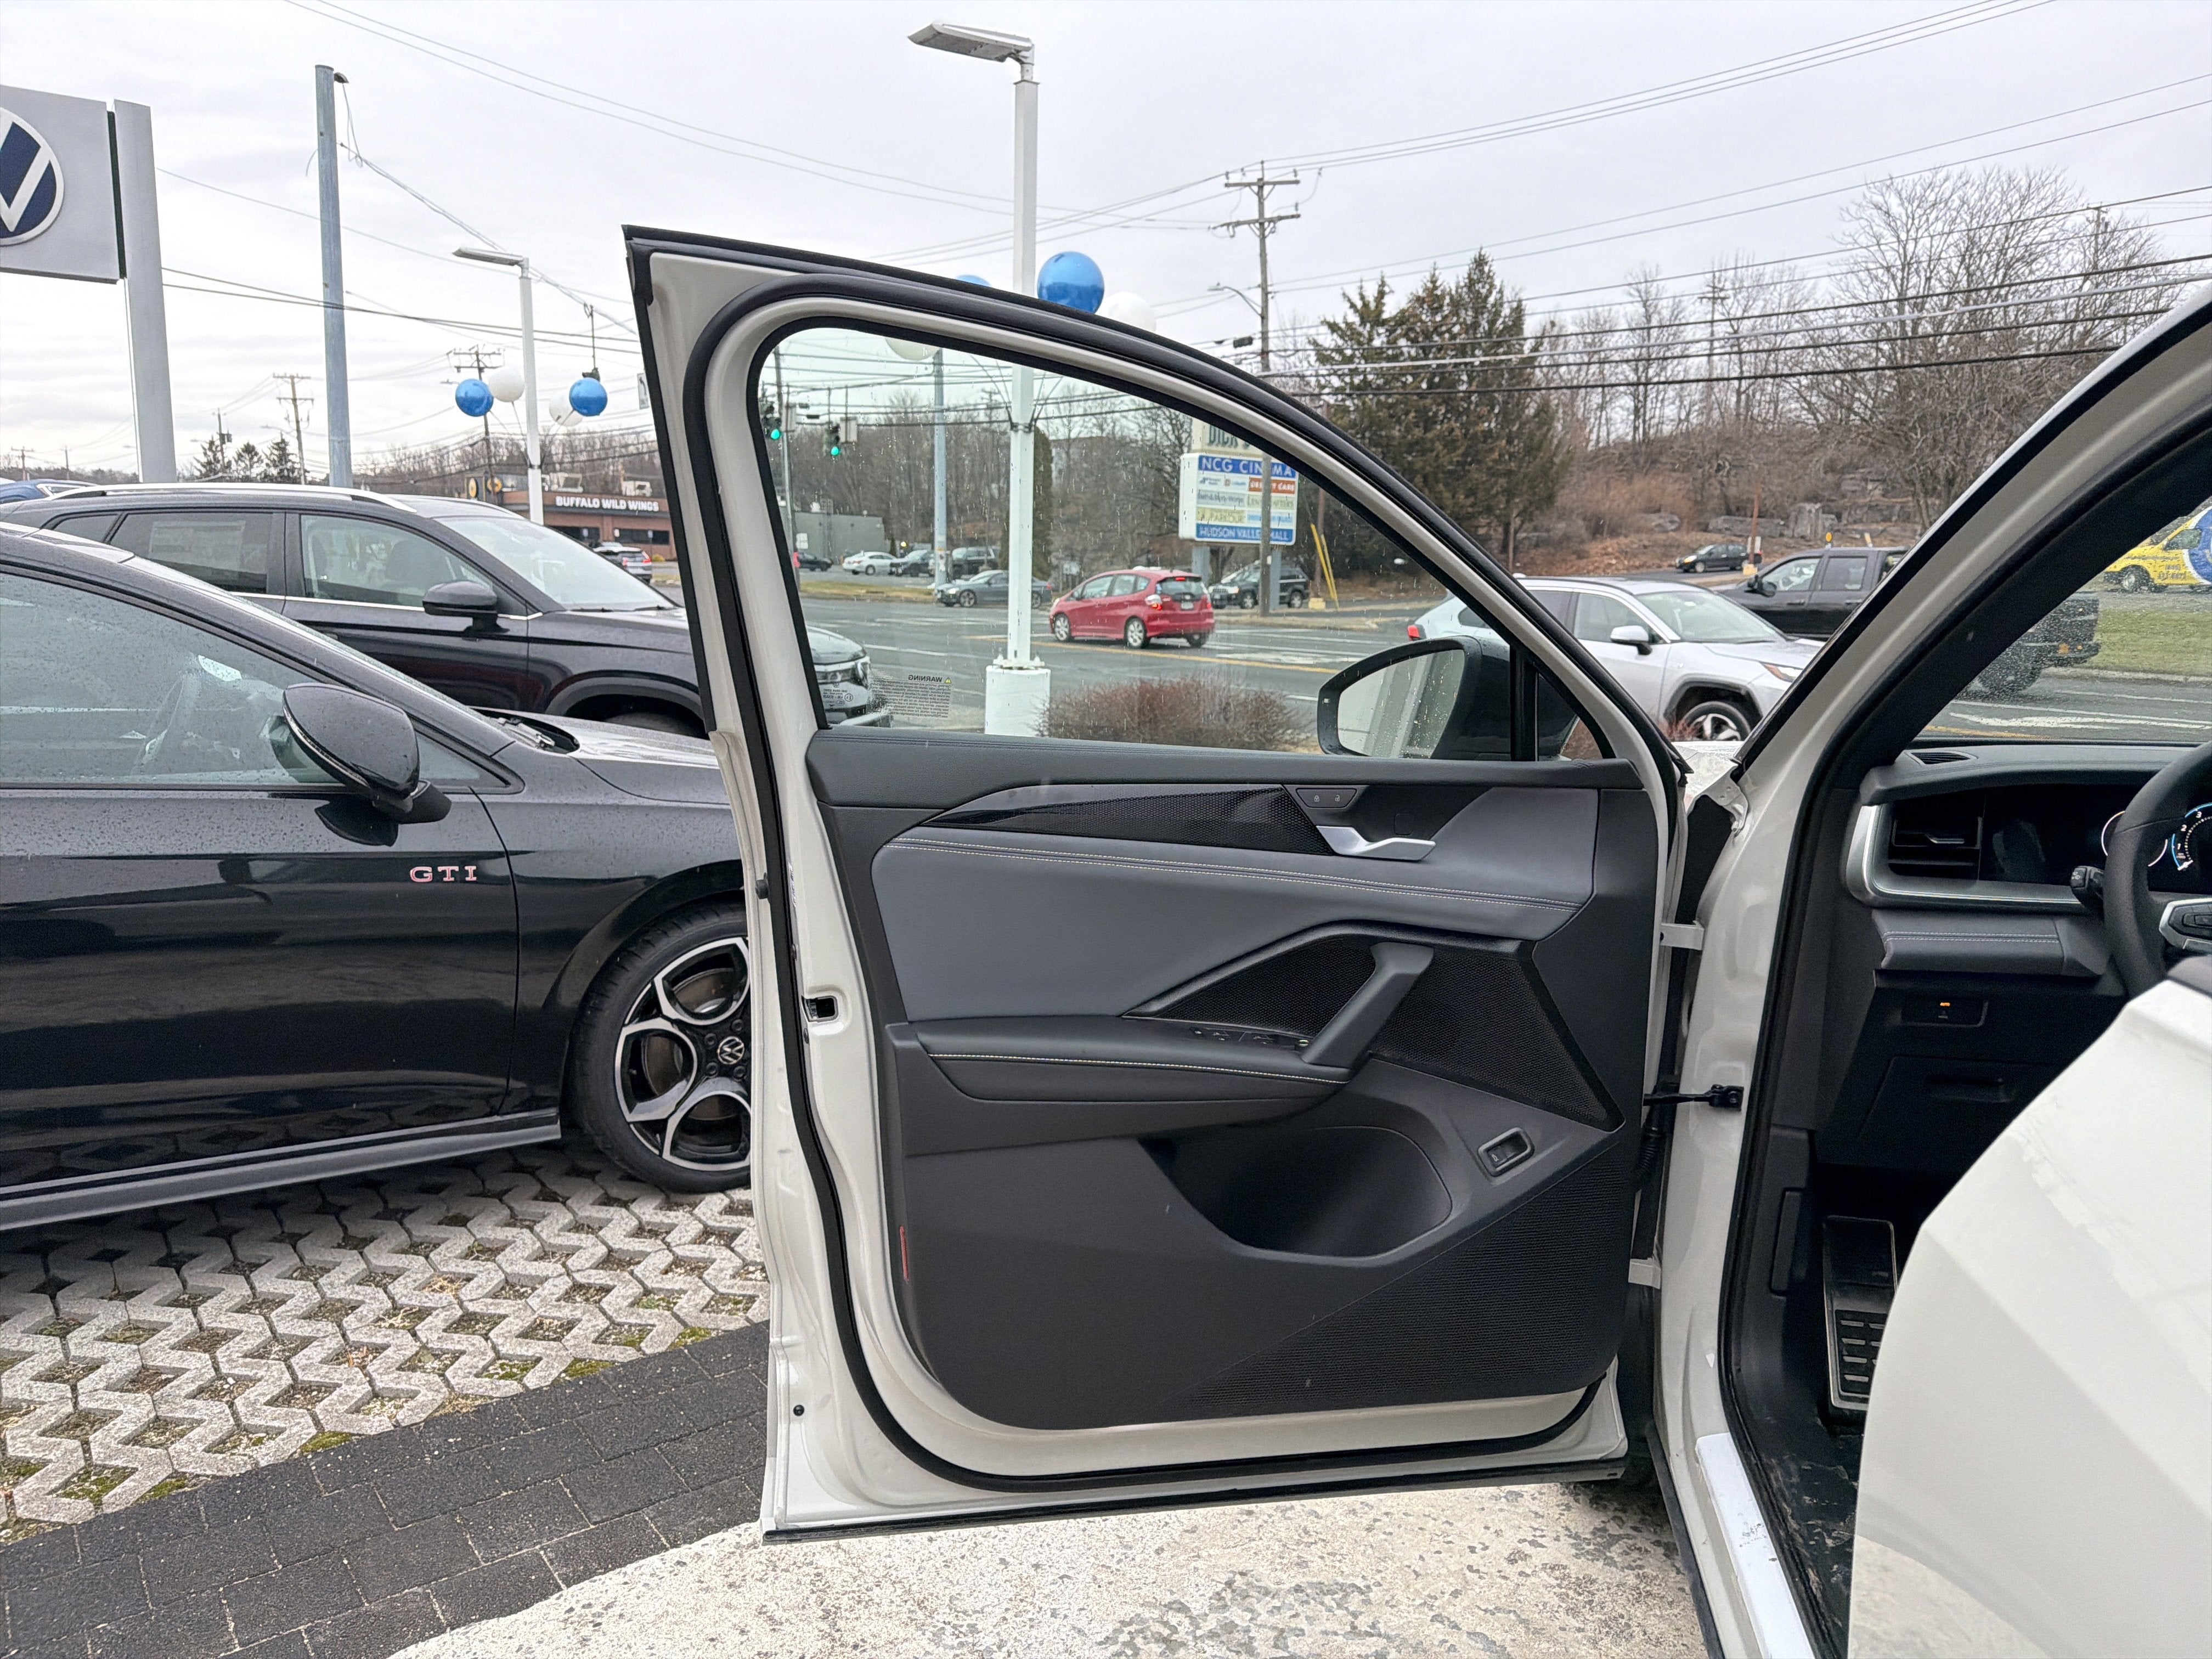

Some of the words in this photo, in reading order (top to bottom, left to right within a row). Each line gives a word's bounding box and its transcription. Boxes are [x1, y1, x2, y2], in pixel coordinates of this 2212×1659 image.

[1201, 457, 1233, 472] NCG
[1239, 460, 1293, 477] CINMA
[555, 495, 600, 509] BUFFALO
[601, 498, 627, 510] WILD
[628, 500, 659, 512] WINGS
[1236, 528, 1262, 539] VALLE
[410, 865, 477, 883] GTI
